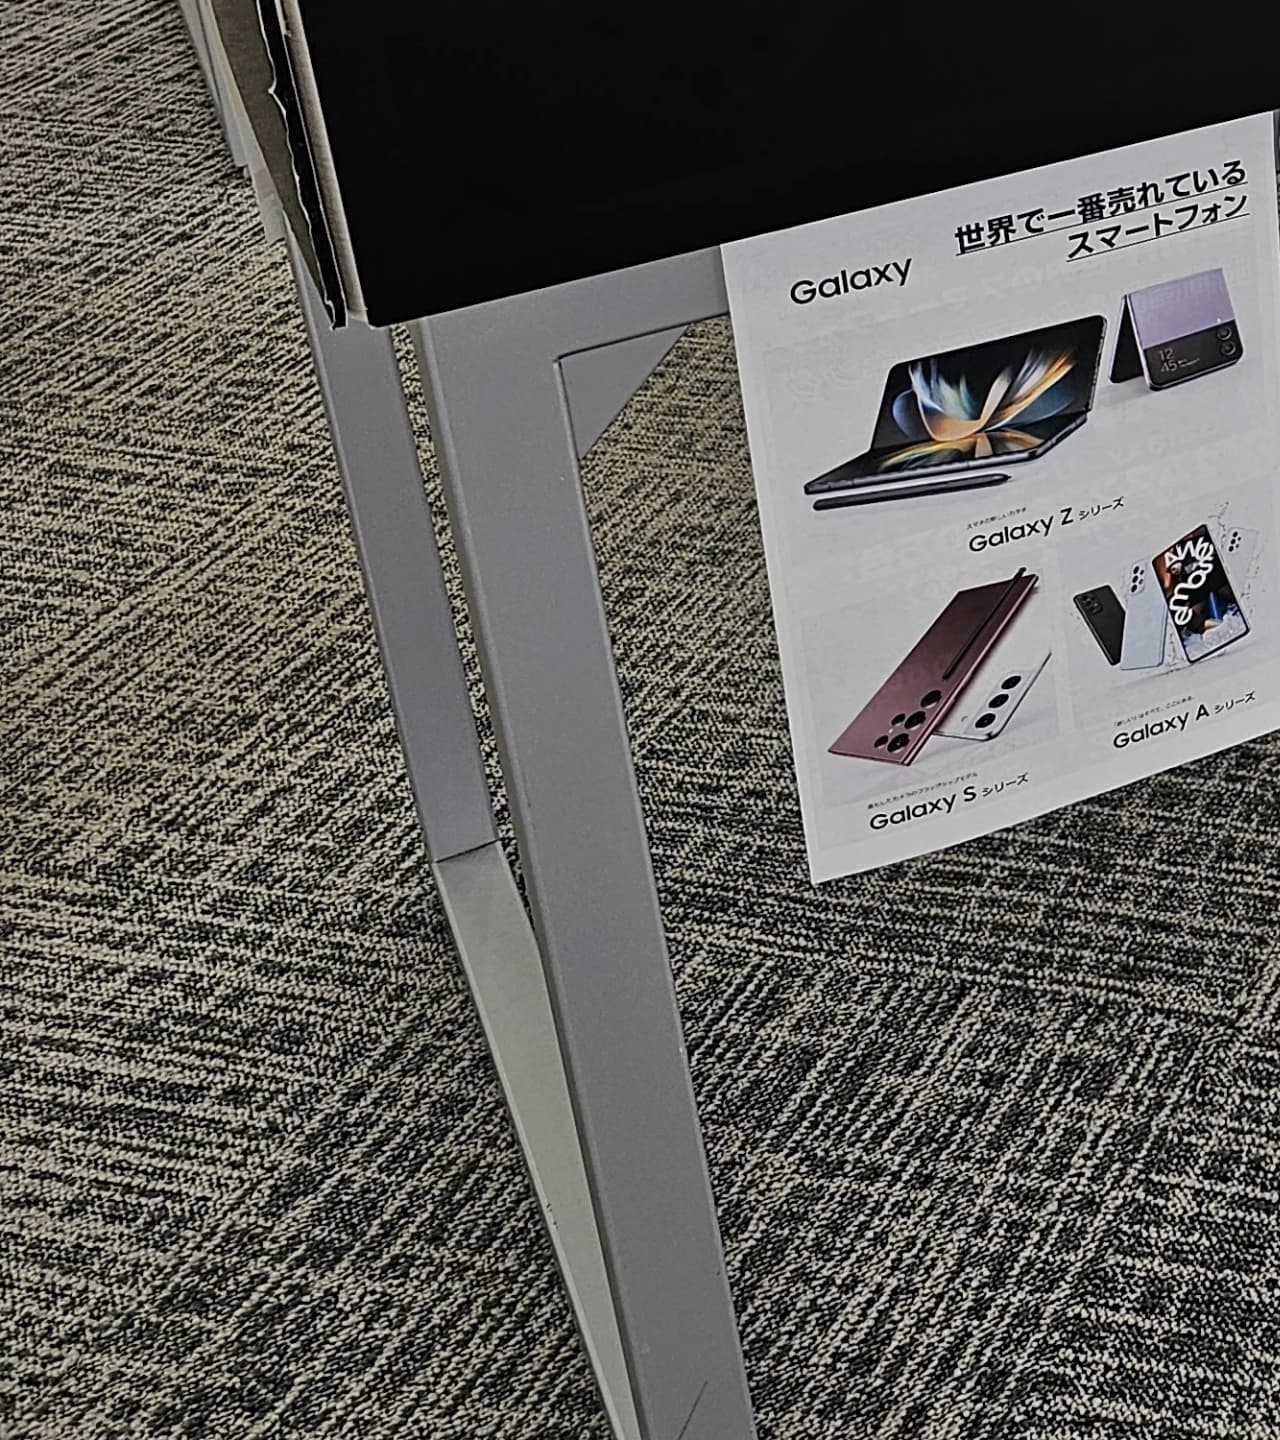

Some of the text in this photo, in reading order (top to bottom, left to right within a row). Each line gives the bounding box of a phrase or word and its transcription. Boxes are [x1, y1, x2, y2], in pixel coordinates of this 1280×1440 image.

[955, 160, 1247, 255] 世界で一番売れている
[1066, 194, 1249, 262] スマートフォン
[790, 258, 912, 305] Galaxy
[969, 497, 1125, 552] Galaxy Z シリーズ
[1112, 691, 1256, 749] Galaxy A シリーズ
[869, 774, 1029, 831] Galaxy S シリーズ
